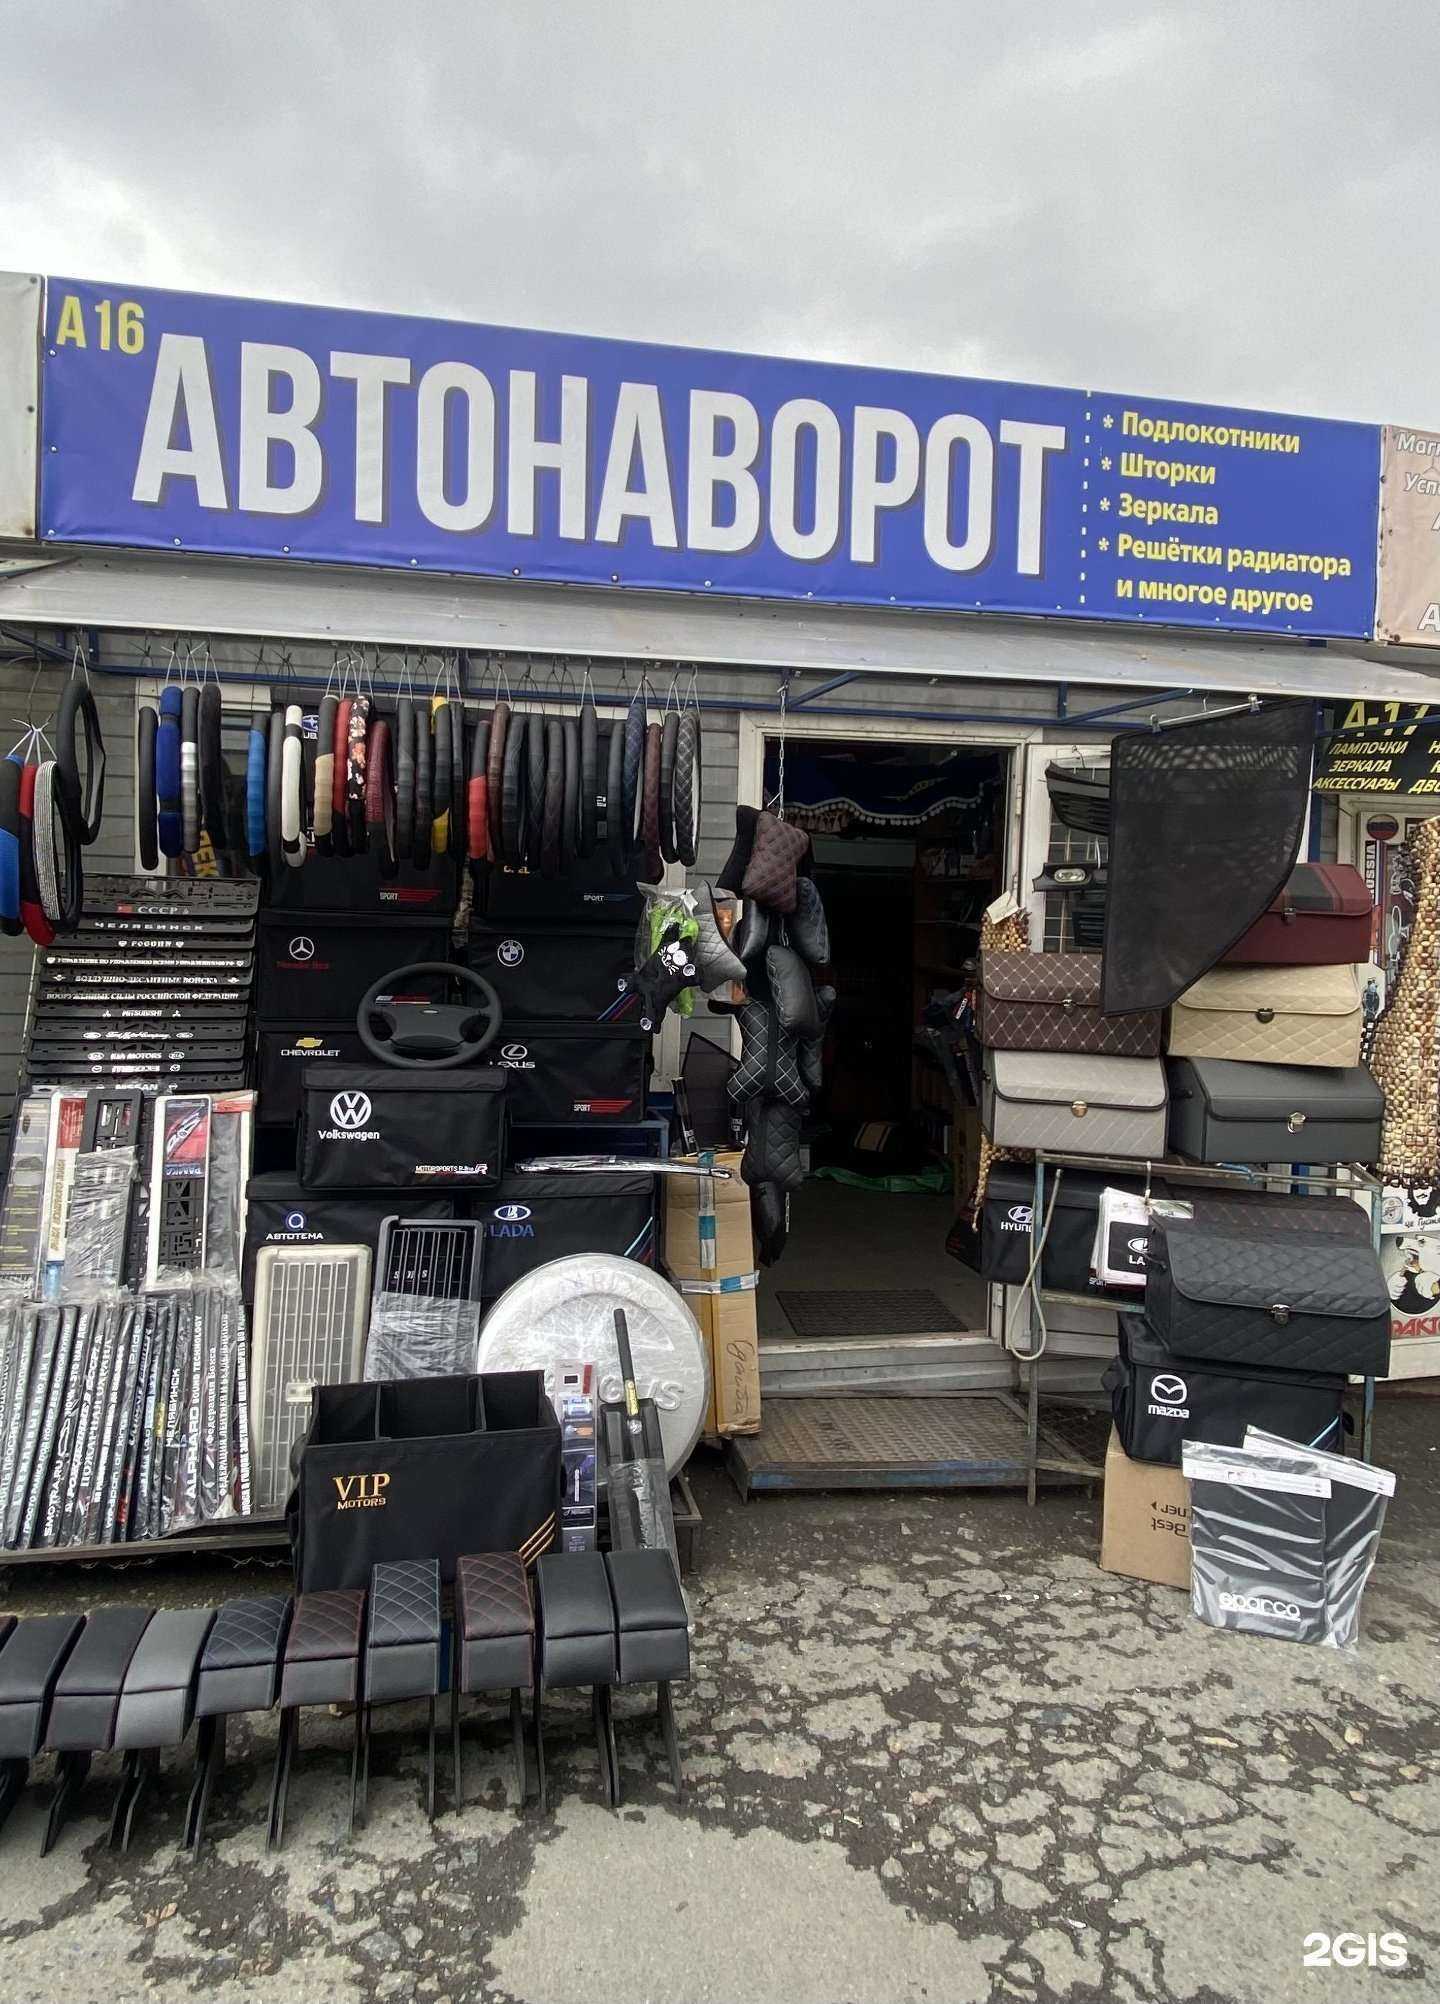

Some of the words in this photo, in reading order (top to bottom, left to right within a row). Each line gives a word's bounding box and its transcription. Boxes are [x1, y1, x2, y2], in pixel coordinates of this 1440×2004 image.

[1121, 411, 1301, 454] Подлокотники
[132, 333, 1066, 577] АВТОНАВОРОТ
[1120, 452, 1216, 485] Шторки
[1118, 493, 1220, 526] Зеркала
[1117, 533, 1223, 568] Решётки
[1227, 548, 1352, 577] радиатора
[1116, 578, 1133, 598] и
[1139, 580, 1227, 607] многое
[1231, 587, 1314, 613] другое
[1328, 740, 1409, 755] ЛАМПОЧКИ
[1328, 759, 1393, 773] ЗЕРКАЛА
[1312, 777, 1401, 791] АКСЕССУАРЫ
[280, 1049, 341, 1057] CHEVROLET
[573, 1103, 592, 1112] SPORT
[318, 1129, 381, 1142] Volkswagen
[265, 1232, 324, 1241] АВТОТЕМА
[490, 1223, 536, 1238] LADA
[192, 1315, 202, 1371] TECHNOLOGY
[192, 1372, 200, 1403] SOUND
[1147, 1404, 1190, 1419] mazda
[186, 1406, 199, 1498] ALPHARD
[332, 1472, 391, 1501] VIP
[337, 1497, 387, 1510] MOTORS
[1151, 1517, 1189, 1538] Best
[1218, 1591, 1301, 1619] sparco
